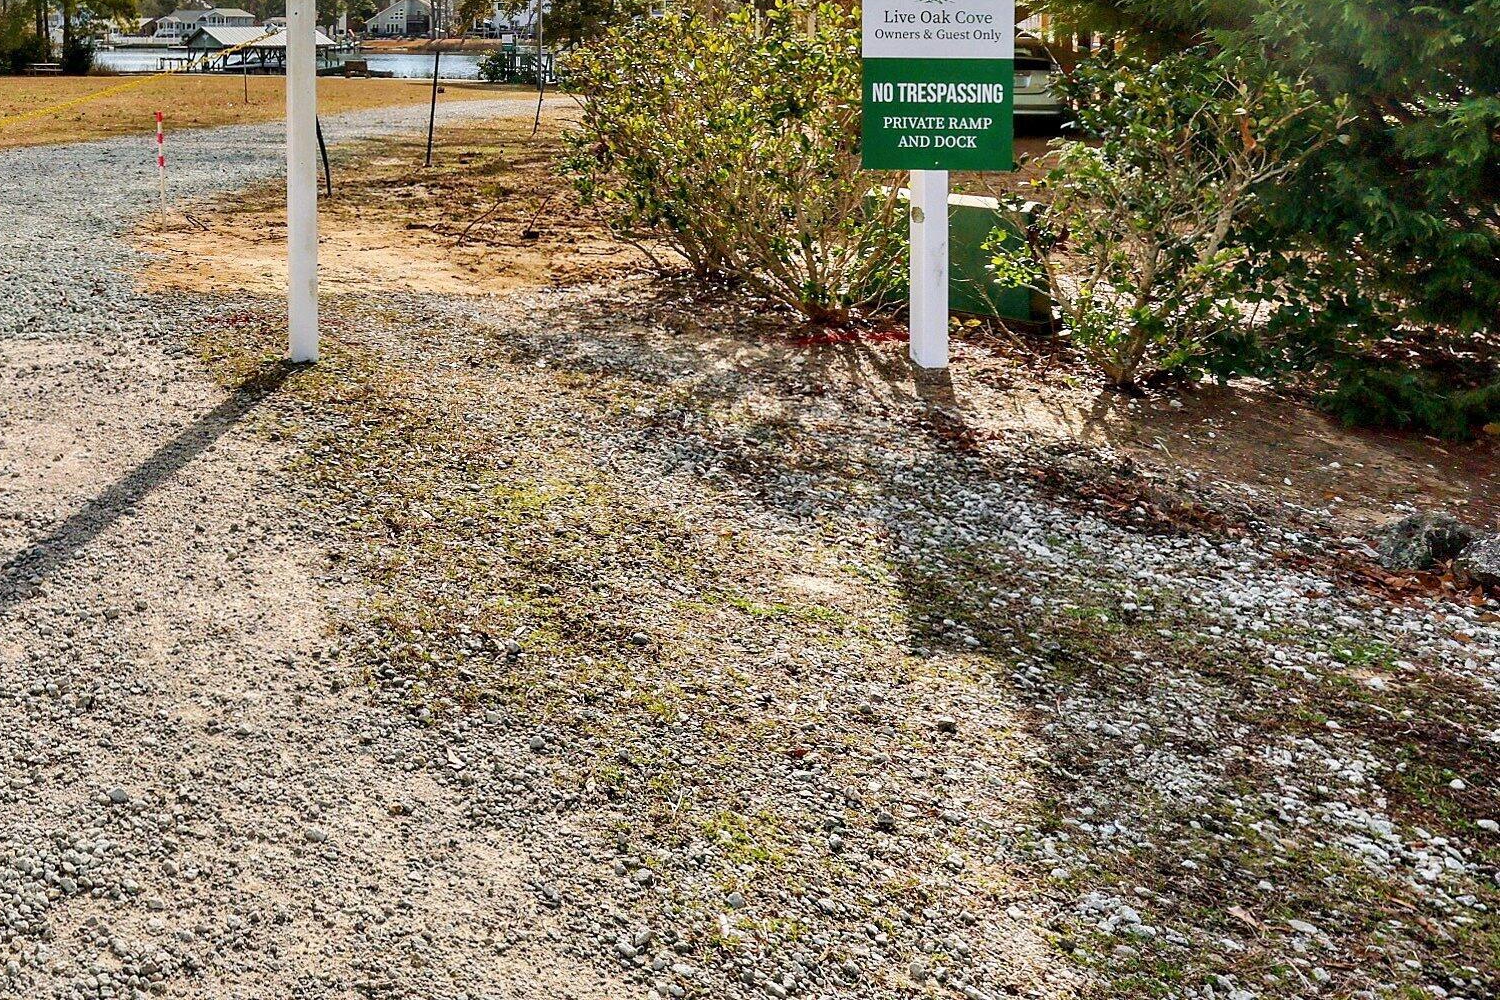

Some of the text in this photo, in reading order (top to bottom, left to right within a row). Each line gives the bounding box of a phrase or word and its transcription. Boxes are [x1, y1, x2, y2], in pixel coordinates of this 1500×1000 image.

[884, 10, 993, 24] Live Oak Cove
[874, 29, 1002, 43] Owners & Guest Only
[872, 82, 1004, 104] NO TRESPASSING
[883, 117, 993, 130] PRIVATE RAMP
[898, 136, 977, 149] AND DOCK
